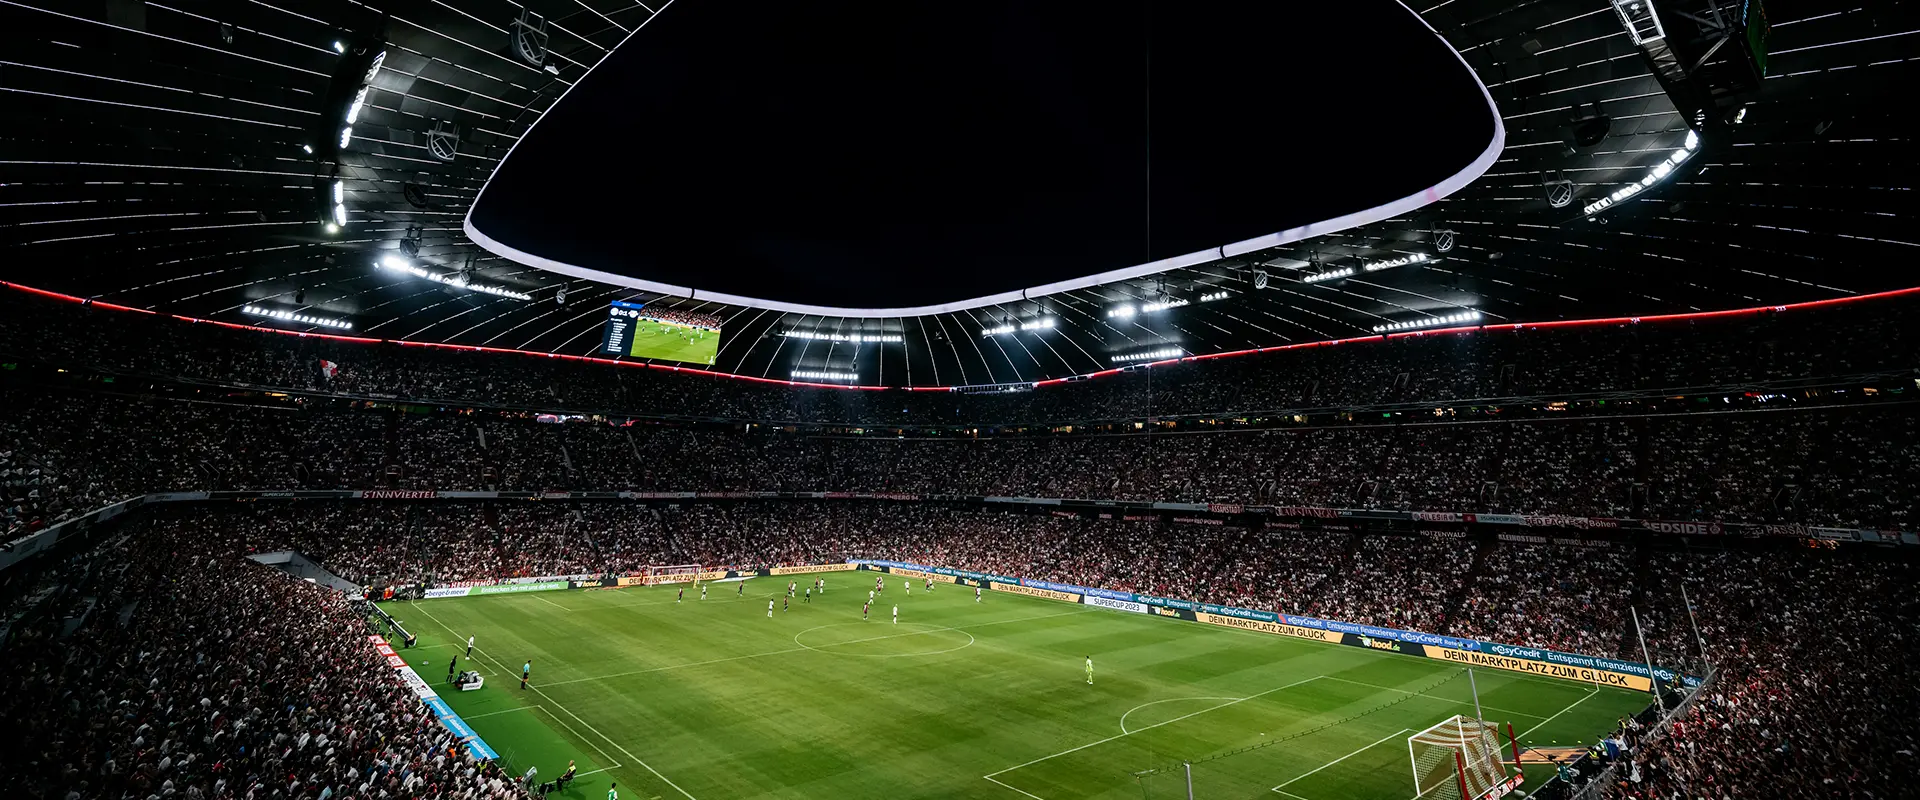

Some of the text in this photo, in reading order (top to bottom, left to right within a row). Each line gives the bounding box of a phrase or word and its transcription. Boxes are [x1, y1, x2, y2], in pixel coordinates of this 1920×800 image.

[1010, 585, 1040, 596] MARKTPLATZ
[1094, 598, 1140, 611] SUPERCUP 2023
[1208, 615, 1327, 640] DEIN MARKTPLATZ ZUM GLÜCK
[1326, 622, 1359, 634] Entspannt
[1360, 626, 1397, 639] finanzieren
[1443, 649, 1629, 687] DEIN MARKTPLATZ ZUM GLÜCK
[1546, 652, 1595, 669] Entspannt
[1595, 658, 1649, 676] finanzieren
